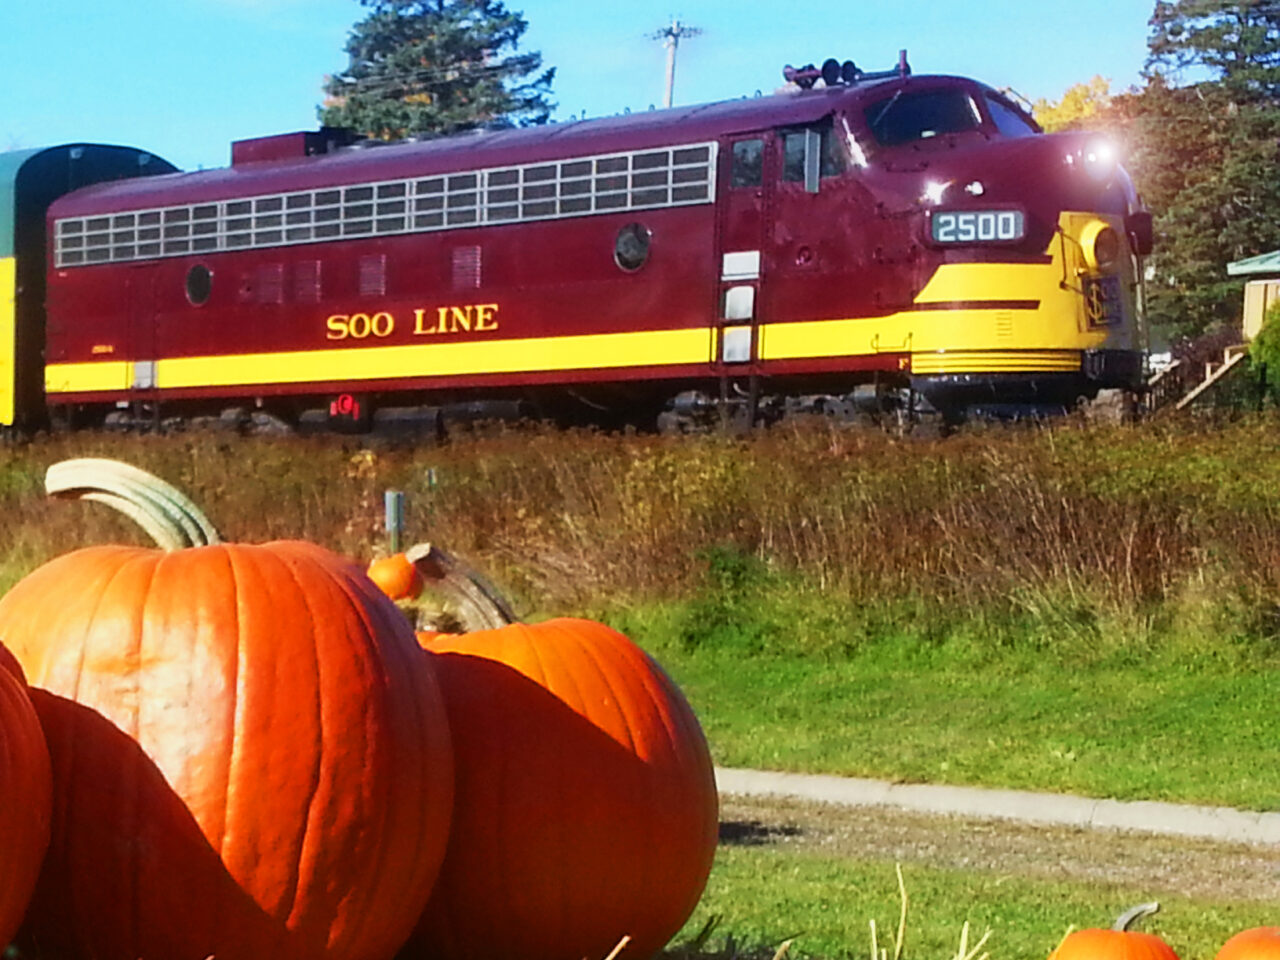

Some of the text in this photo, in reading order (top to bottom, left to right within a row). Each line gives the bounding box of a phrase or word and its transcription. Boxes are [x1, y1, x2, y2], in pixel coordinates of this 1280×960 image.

[938, 212, 1015, 241] 2500
[326, 304, 498, 339] SOO LINE
